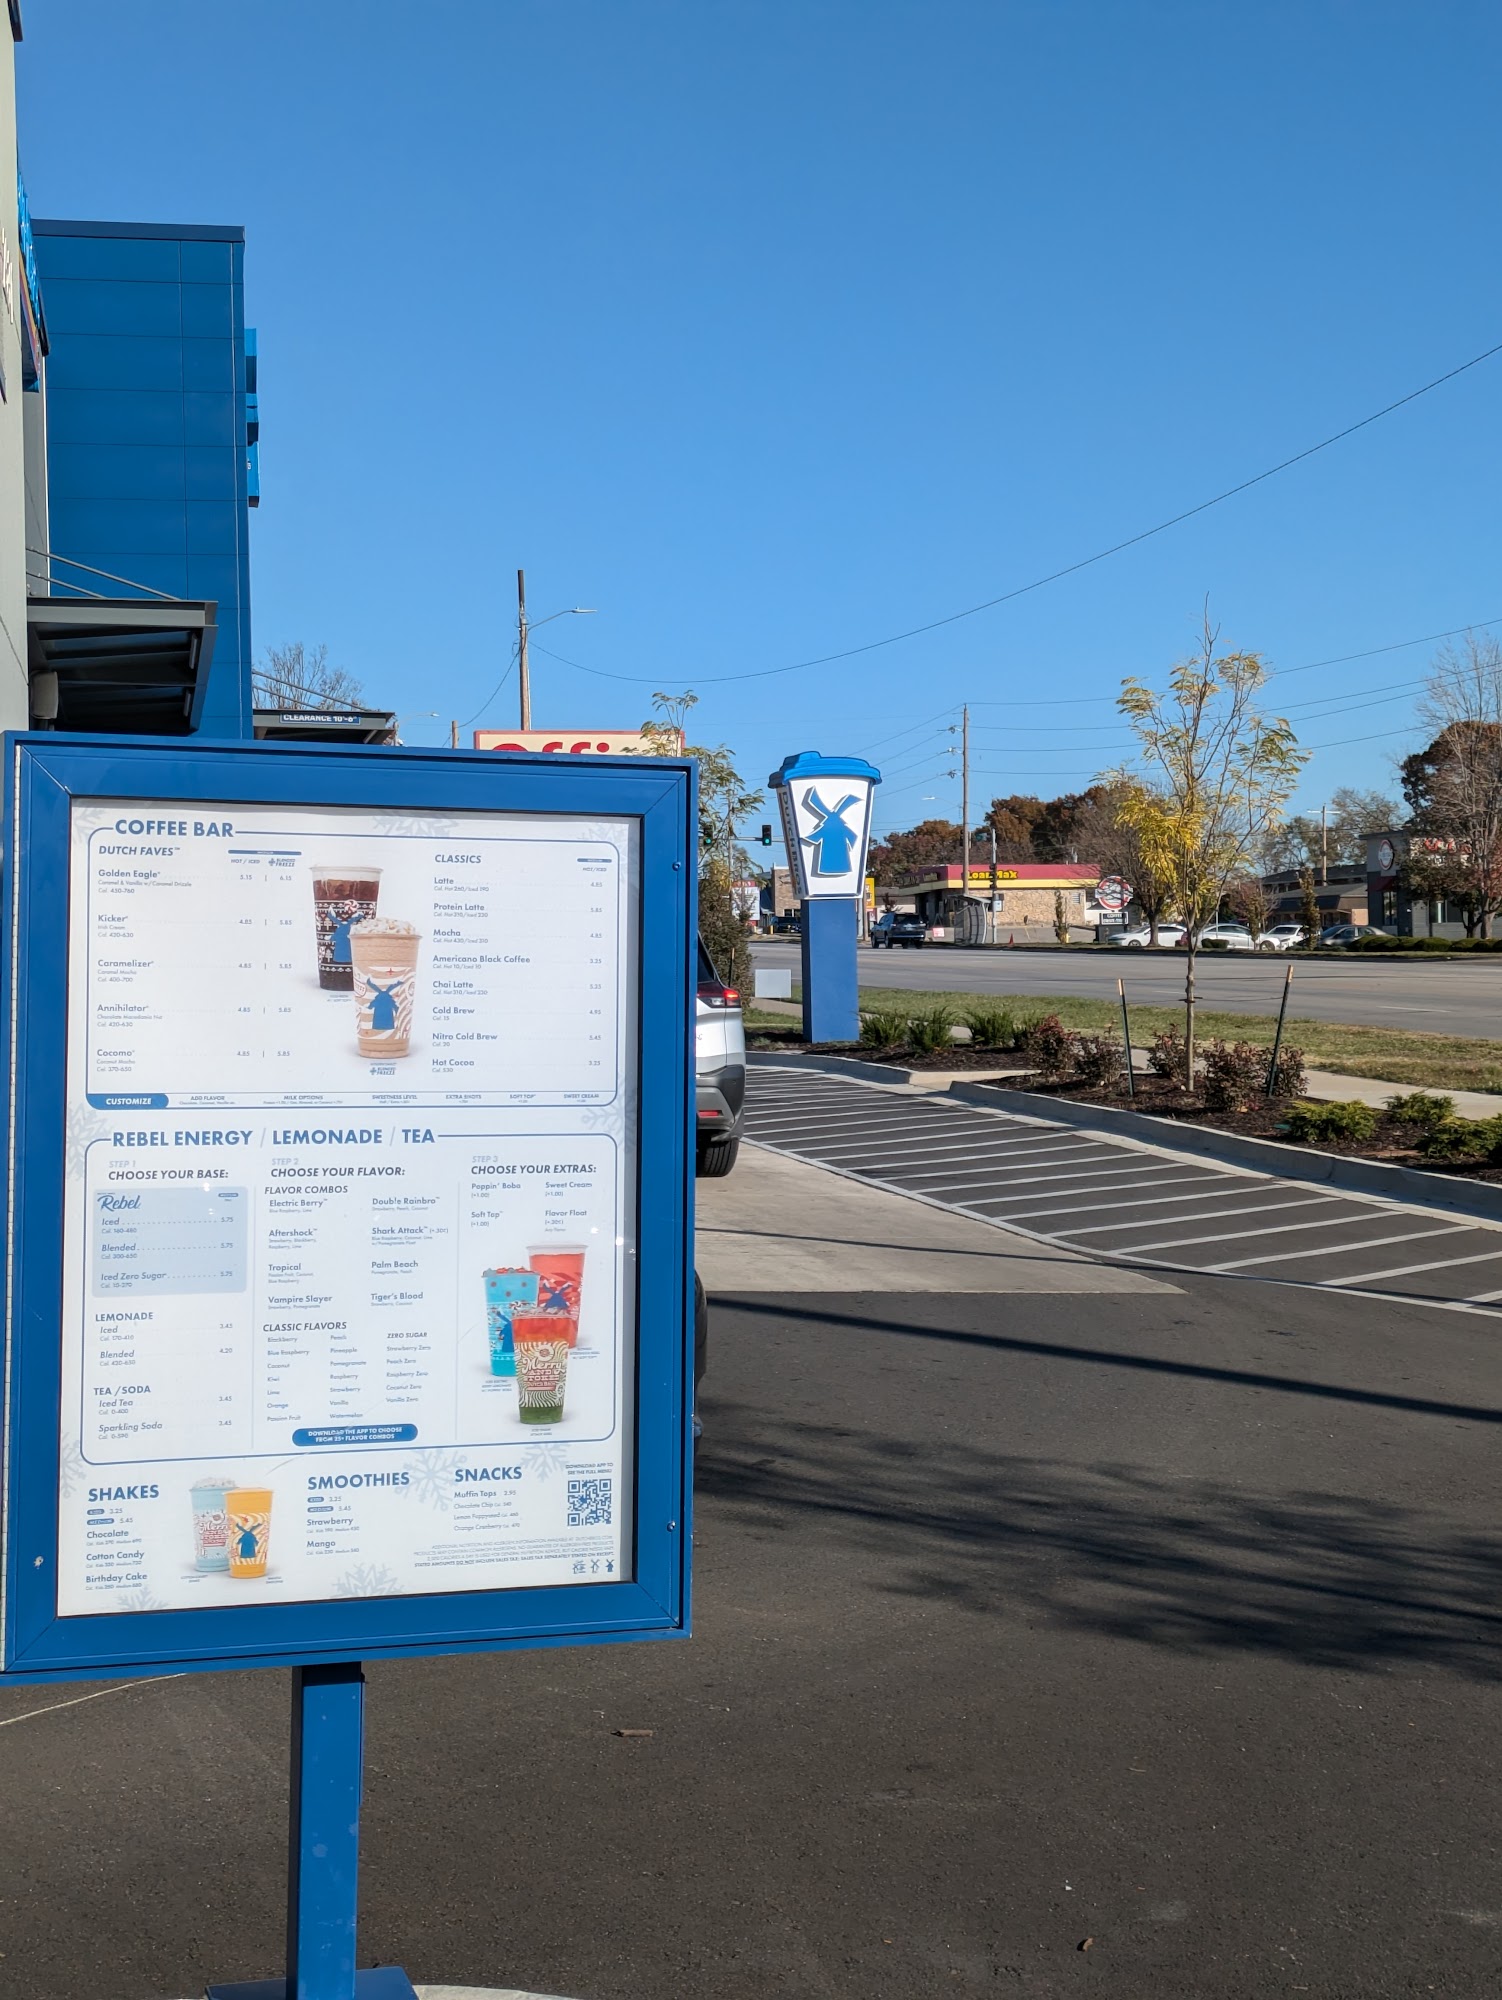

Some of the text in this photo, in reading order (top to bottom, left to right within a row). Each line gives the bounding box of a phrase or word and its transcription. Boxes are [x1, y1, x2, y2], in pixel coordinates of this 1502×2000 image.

[283, 714, 332, 722] CLEARANCE
[116, 820, 233, 837] COFFEE BAR
[99, 846, 137, 855] DUTCH
[435, 855, 481, 863] CLASSICS
[99, 869, 130, 877] Golden
[504, 955, 530, 963] Coffee
[113, 1129, 434, 1146] REBEL ENERGY LEMONADE TEA
[109, 1160, 129, 1168] STEP
[271, 1167, 405, 1177] CHOOSE YOUR FLAVOR:
[471, 1164, 596, 1174] CHOOSE YOUR EXTRAS:
[109, 1170, 228, 1180] CHOOSE YOUR BASE:
[97, 1195, 140, 1212] Rebel
[373, 1197, 401, 1205] Double
[102, 1217, 119, 1225] Iced
[102, 1243, 136, 1251] Blended
[269, 1263, 301, 1272] Tropical
[141, 1272, 167, 1281] Sugar
[268, 1295, 332, 1304] Vampire Slayer
[96, 1312, 153, 1321] LEMONADE
[263, 1322, 346, 1332] CLASSIC FLAVORS
[100, 1350, 134, 1358] Blended
[522, 1358, 566, 1374] Merry
[94, 1387, 111, 1395] TEA
[99, 1399, 117, 1407] Iced
[99, 1421, 162, 1434] Sparkling Soda
[455, 1466, 522, 1482] SNACKS
[308, 1472, 409, 1490] SMOOTHIES
[88, 1485, 159, 1502] SHAKES
[307, 1517, 353, 1526] Strawberry
[87, 1530, 128, 1538] Chocolate
[117, 1550, 144, 1559] Candy
[86, 1574, 123, 1583] Birthday
